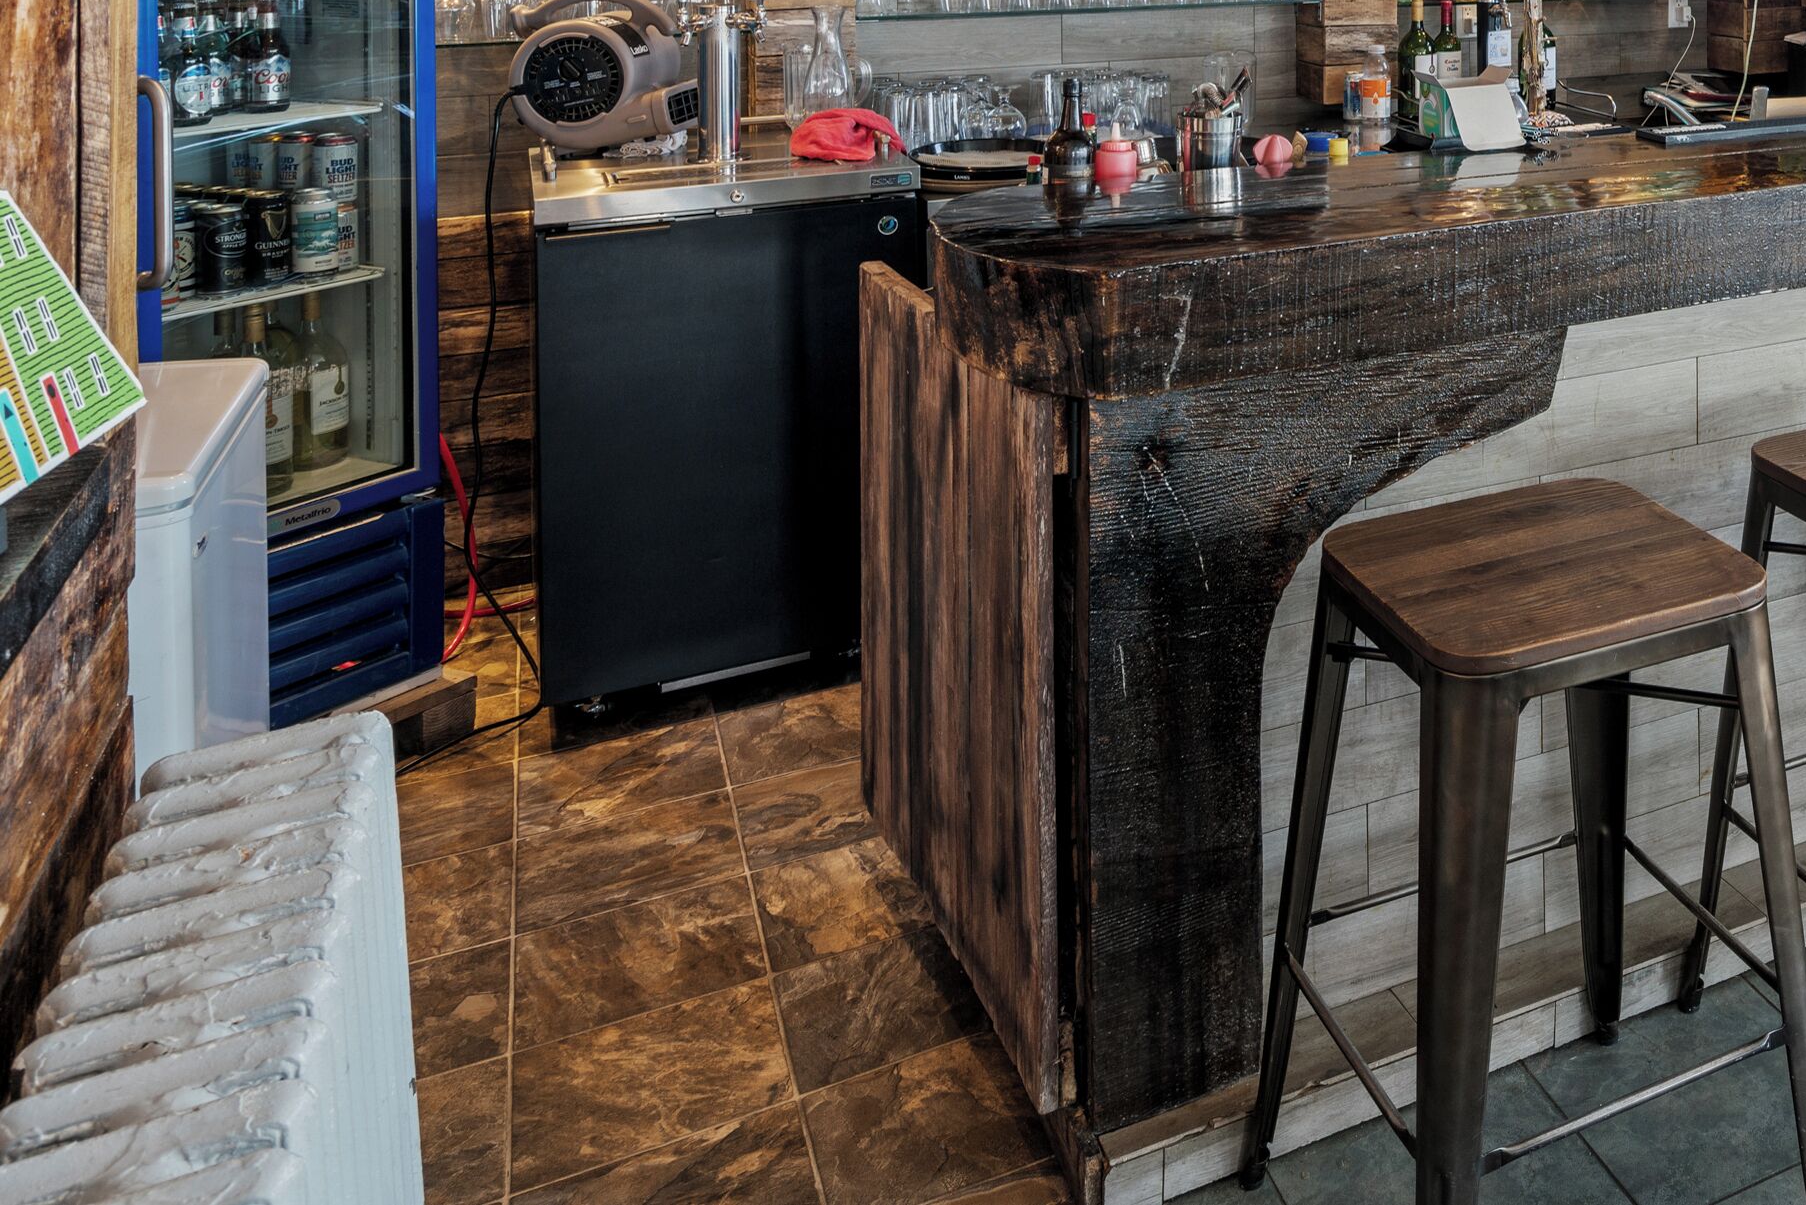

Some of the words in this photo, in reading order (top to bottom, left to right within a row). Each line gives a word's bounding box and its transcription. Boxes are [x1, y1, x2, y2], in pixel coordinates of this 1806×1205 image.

[260, 86, 288, 94] LIGH
[330, 158, 354, 166] BUD
[326, 164, 356, 175] LIGHT
[284, 506, 332, 526] Metalfrio
